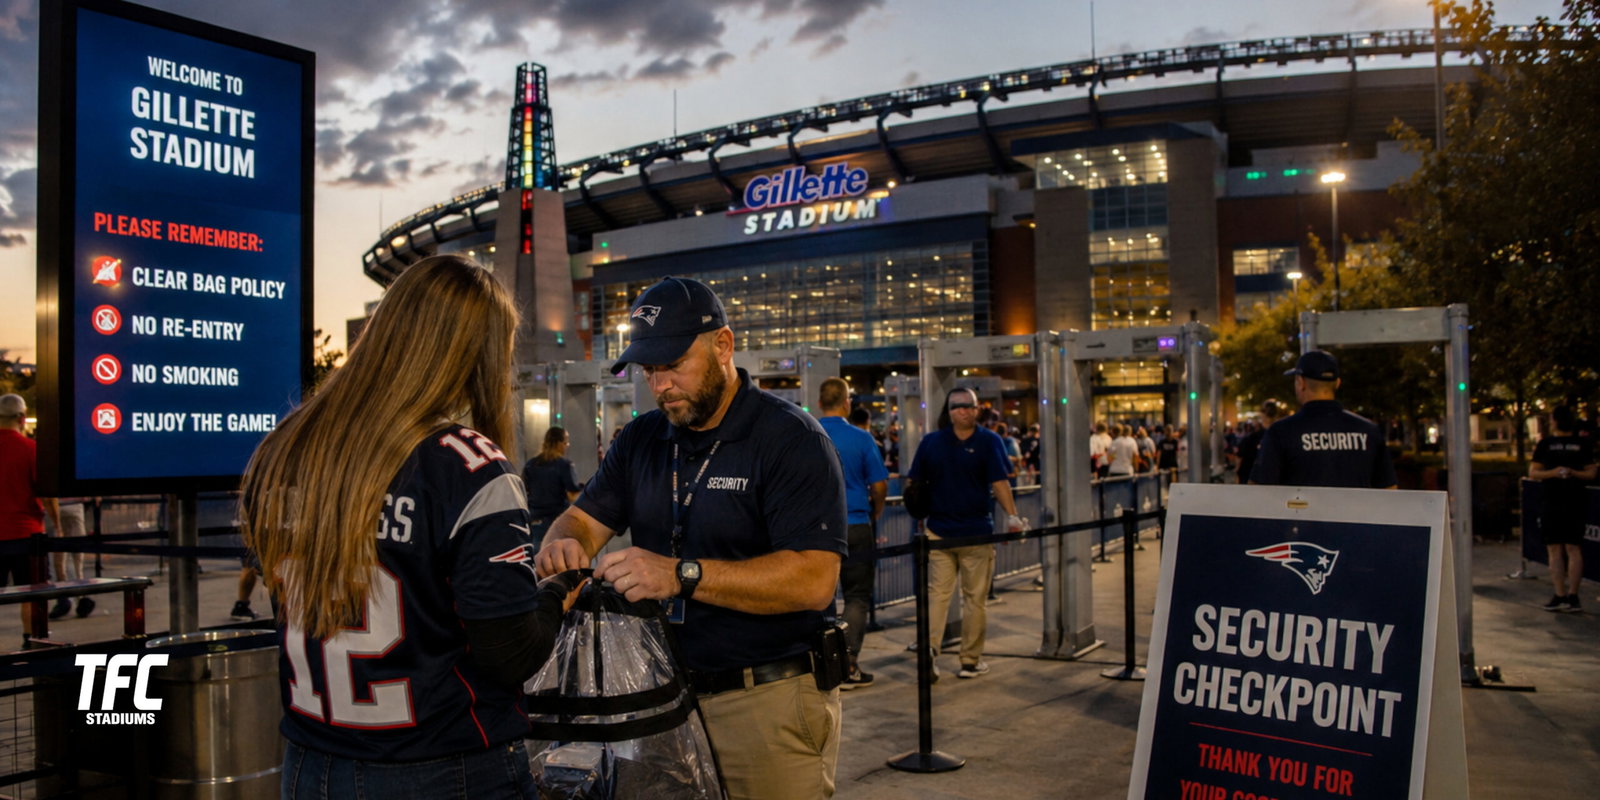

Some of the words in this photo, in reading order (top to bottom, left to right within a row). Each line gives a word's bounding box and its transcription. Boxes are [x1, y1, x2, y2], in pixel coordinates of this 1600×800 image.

[147, 56, 221, 91] WELCOME
[225, 75, 243, 95] TO
[131, 86, 256, 141] GILLETTE
[130, 126, 255, 178] STADIUM
[744, 161, 868, 210] Gillette
[94, 212, 162, 240] PLEASE
[168, 223, 263, 251] REMEMBER:
[743, 199, 876, 234] STADIUM
[132, 266, 187, 290] CLEAR
[193, 272, 226, 294] BAG
[231, 276, 286, 299] POLICY
[132, 315, 157, 336] NO
[162, 318, 244, 341] RE-ENTRY
[132, 363, 157, 383] NO
[162, 365, 239, 386] SMOKING
[132, 412, 186, 432] ENJOY
[191, 413, 223, 432] THE
[227, 413, 277, 432] GAME!
[1301, 432, 1367, 451] SECURITY
[439, 427, 508, 472] 12
[706, 476, 748, 491] SECURITY
[273, 553, 417, 730] 12
[1192, 604, 1395, 674] SECURITY
[1173, 662, 1402, 738] CHECKPOINT
[1198, 743, 1262, 778] THANK
[1268, 755, 1308, 786] YOU
[1313, 764, 1354, 796] FOR
